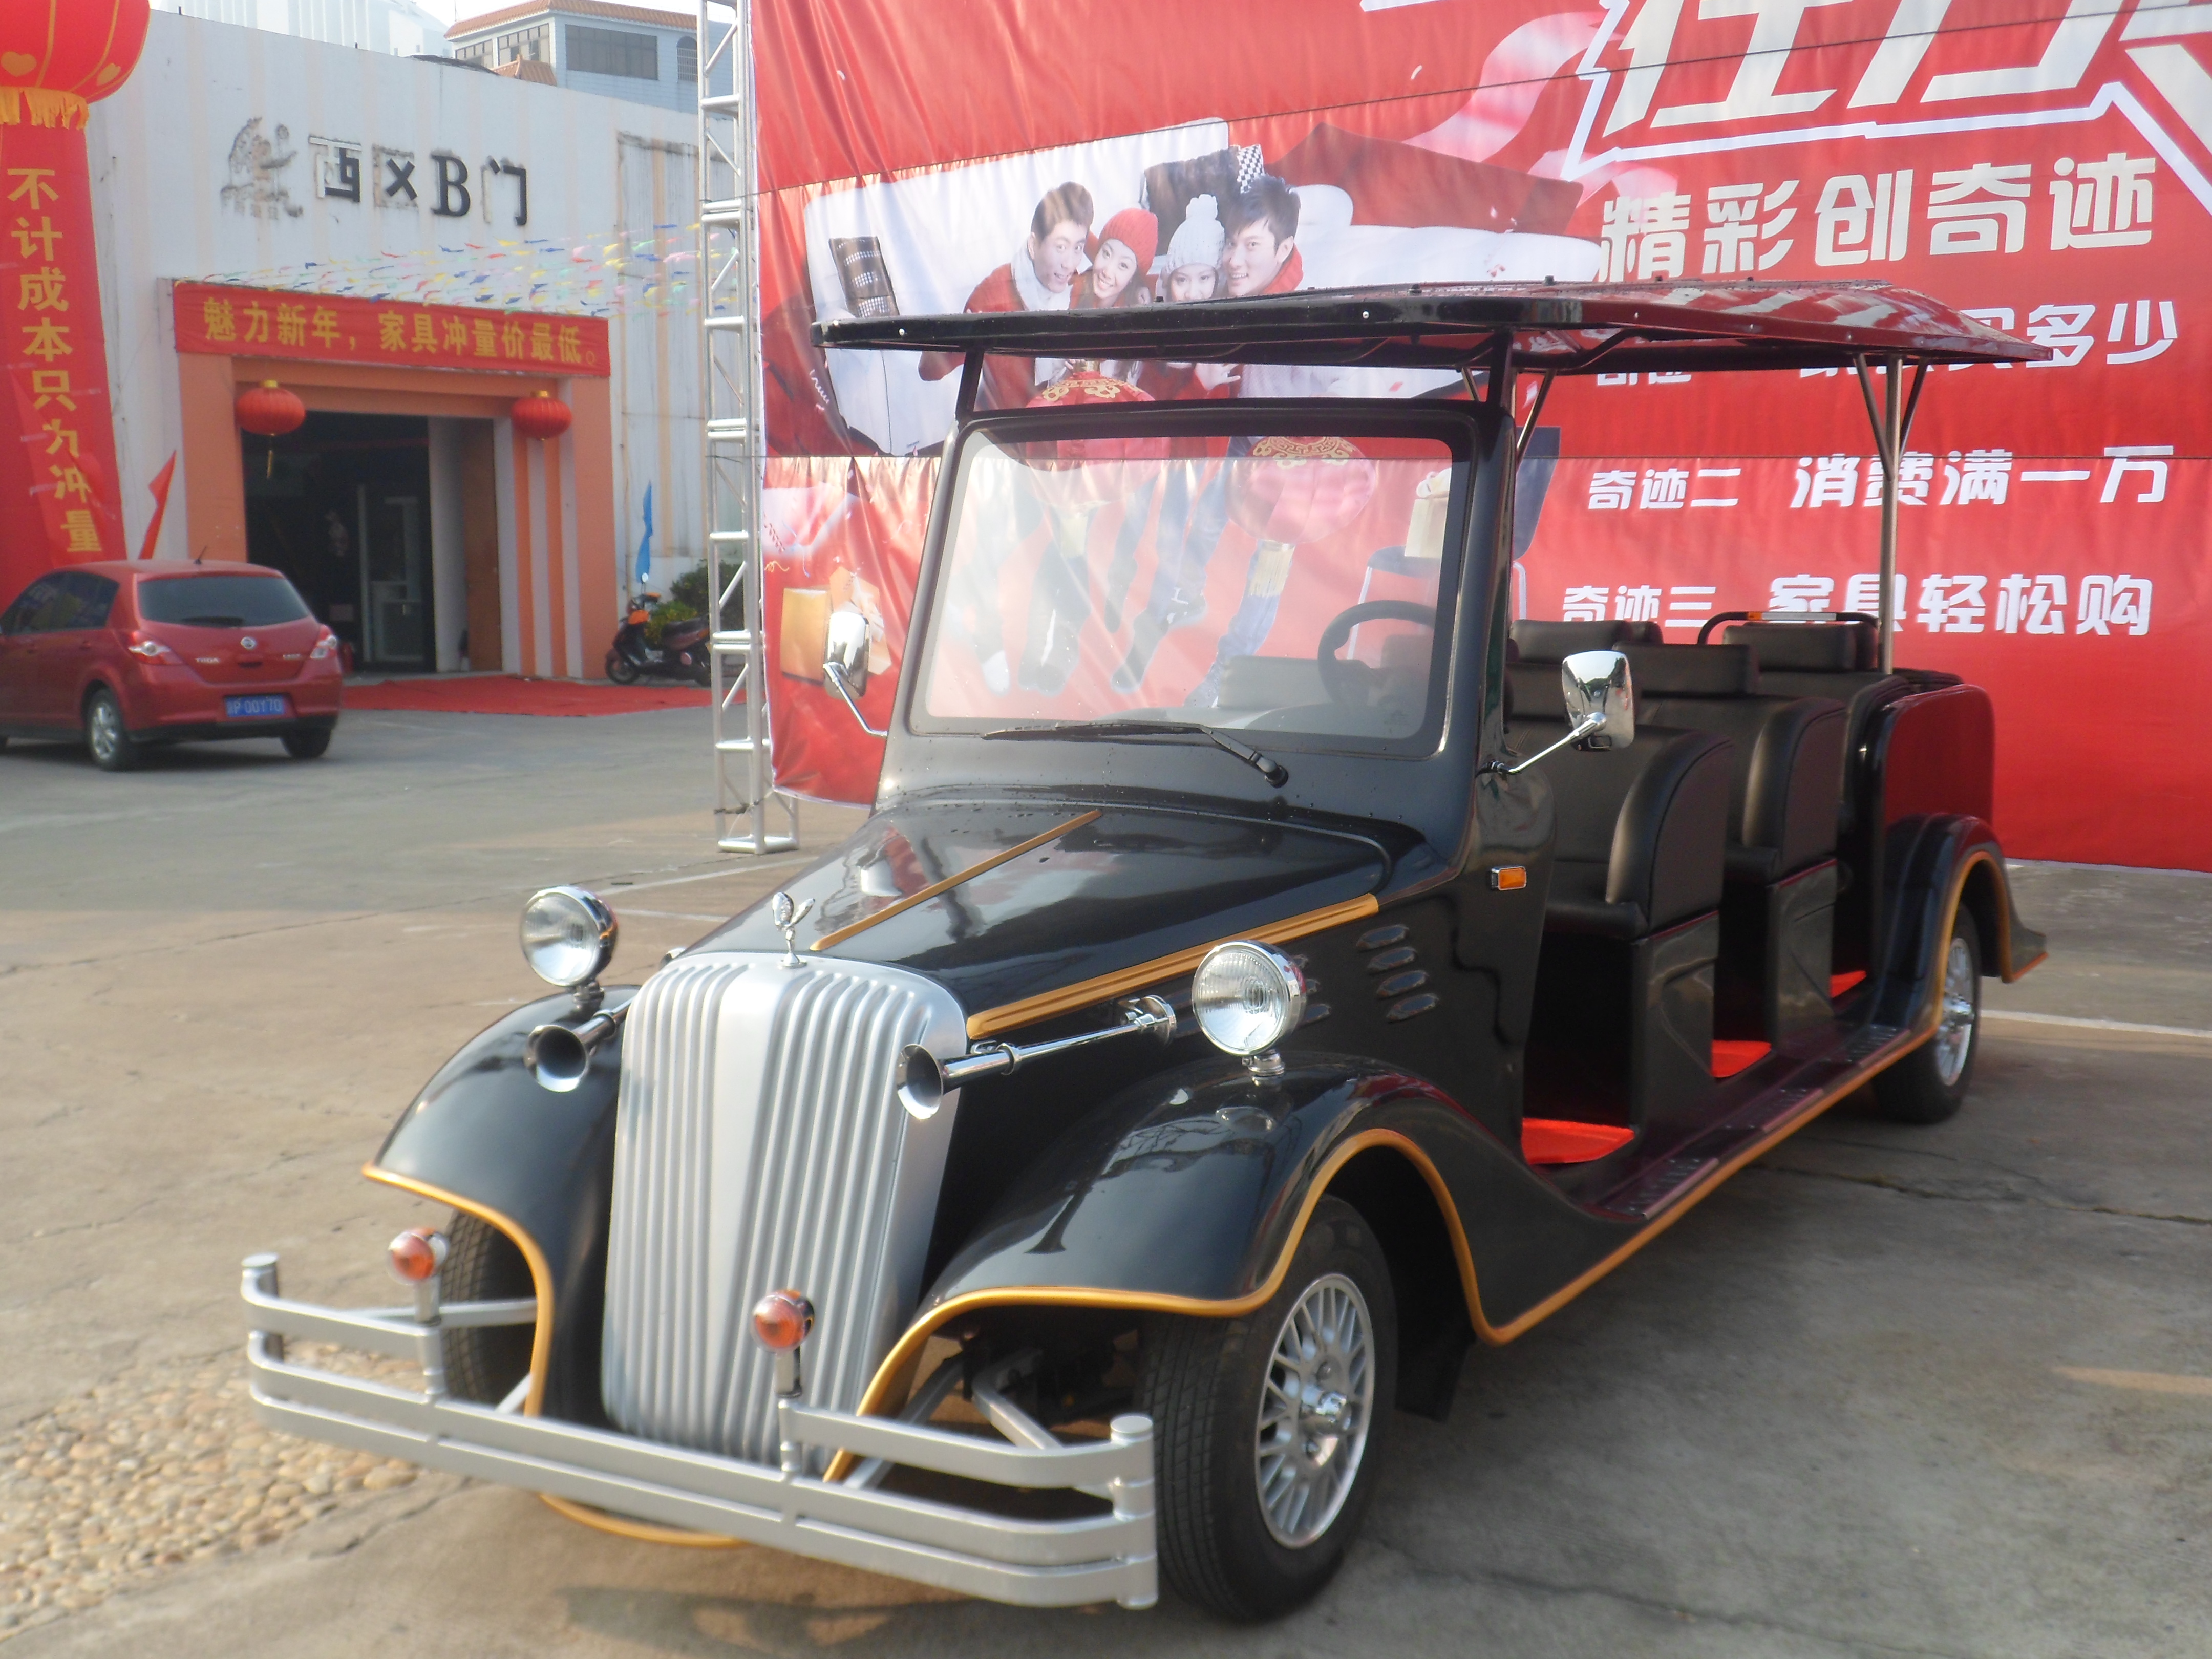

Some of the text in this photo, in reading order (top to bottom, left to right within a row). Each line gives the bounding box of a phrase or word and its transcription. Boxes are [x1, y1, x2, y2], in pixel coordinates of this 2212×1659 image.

[1600, 153, 2156, 282] 精彩创奇迹
[7, 168, 101, 552] 不计成本只为冲量
[1588, 445, 2174, 510] 奇迹二 消费满一万
[1563, 573, 2153, 636] 奇迹三 家具轻松购
